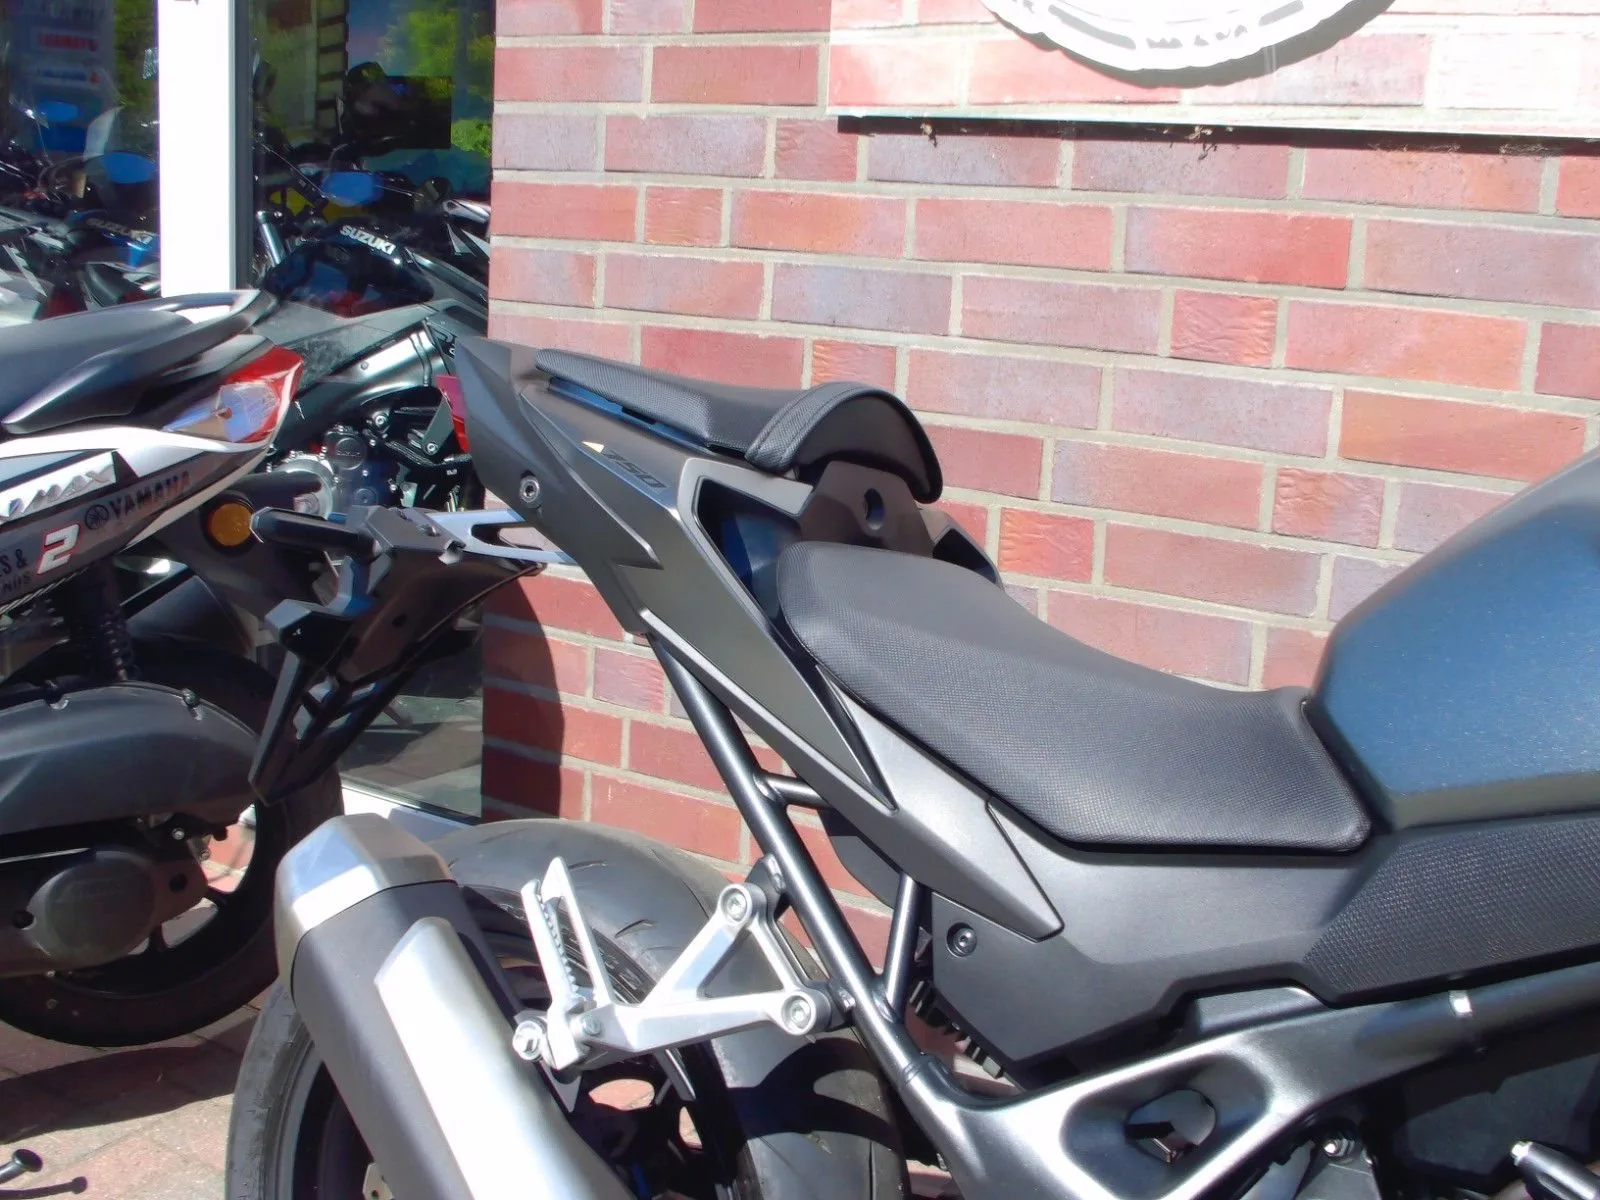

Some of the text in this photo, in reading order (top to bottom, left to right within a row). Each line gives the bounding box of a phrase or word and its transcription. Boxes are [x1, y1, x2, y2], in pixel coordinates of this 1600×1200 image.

[340, 225, 396, 255] SUZUKI
[109, 470, 190, 518] YAMAHA
[36, 523, 80, 575] 2
